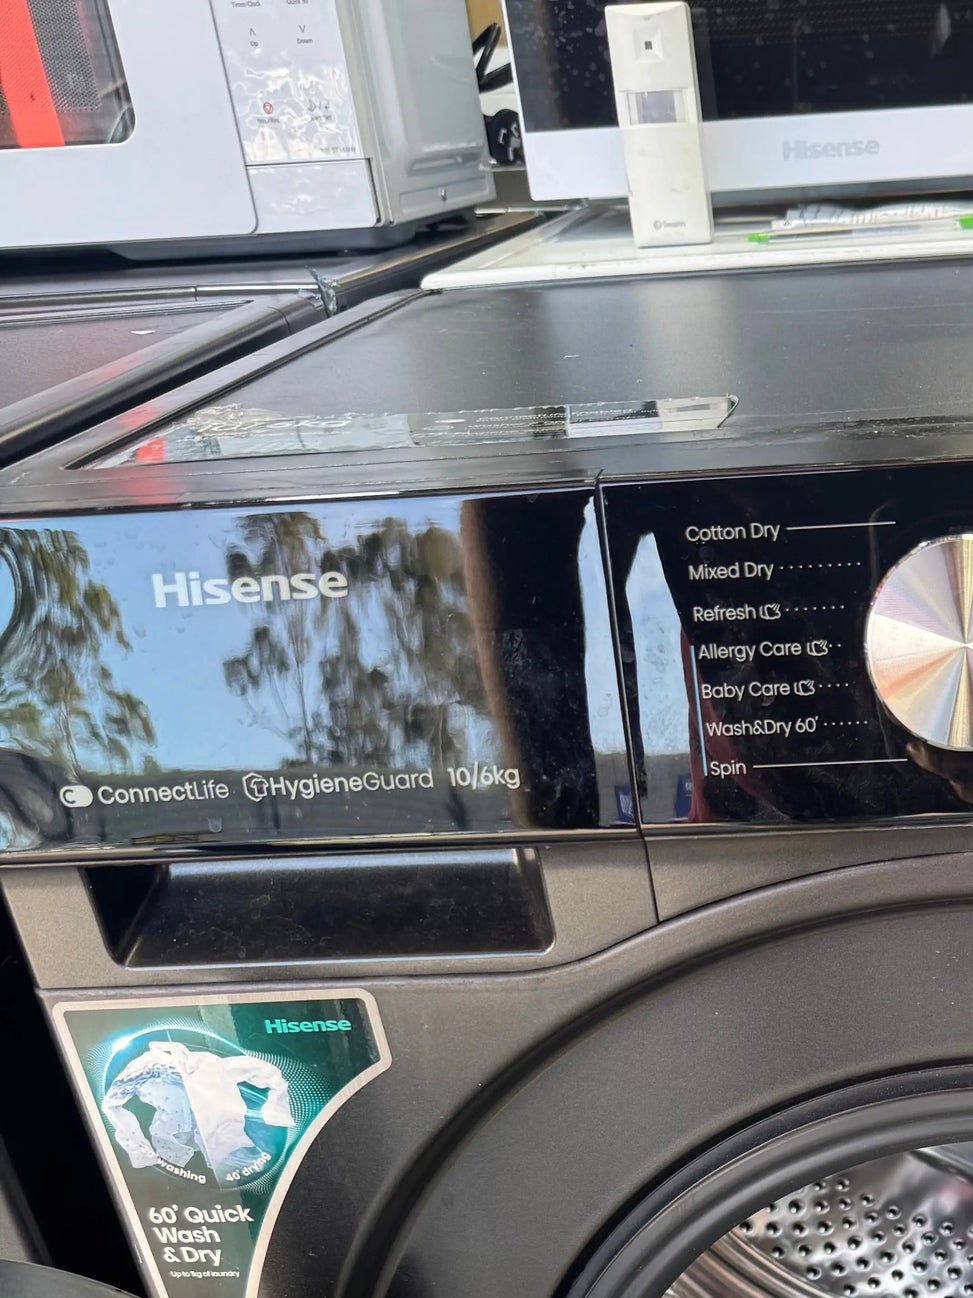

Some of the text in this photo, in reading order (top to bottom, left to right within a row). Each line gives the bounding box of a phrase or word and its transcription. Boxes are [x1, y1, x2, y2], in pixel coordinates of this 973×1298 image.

[783, 139, 880, 161] Hisense
[685, 522, 781, 542] Cotton Dry
[688, 561, 774, 581] Mixed Dry
[152, 570, 348, 609] Hisense
[693, 604, 757, 622] Refresh
[698, 641, 802, 662] Allergy Care
[701, 681, 791, 702] Baby Care
[706, 719, 792, 738] Wash&Dry
[710, 760, 747, 779] Spin
[269, 761, 522, 801] HygieneGuard 10/6kg
[97, 779, 230, 805] ConnectLife
[264, 1019, 352, 1035] Hisense
[156, 1158, 207, 1185] washing
[242, 1151, 272, 1177] drying
[183, 1204, 255, 1224] Quick
[152, 1225, 222, 1244] Wash
[162, 1246, 222, 1267] & Dry
[170, 1270, 182, 1279] Up
[182, 1270, 191, 1278] to
[210, 1270, 240, 1278] laundry
